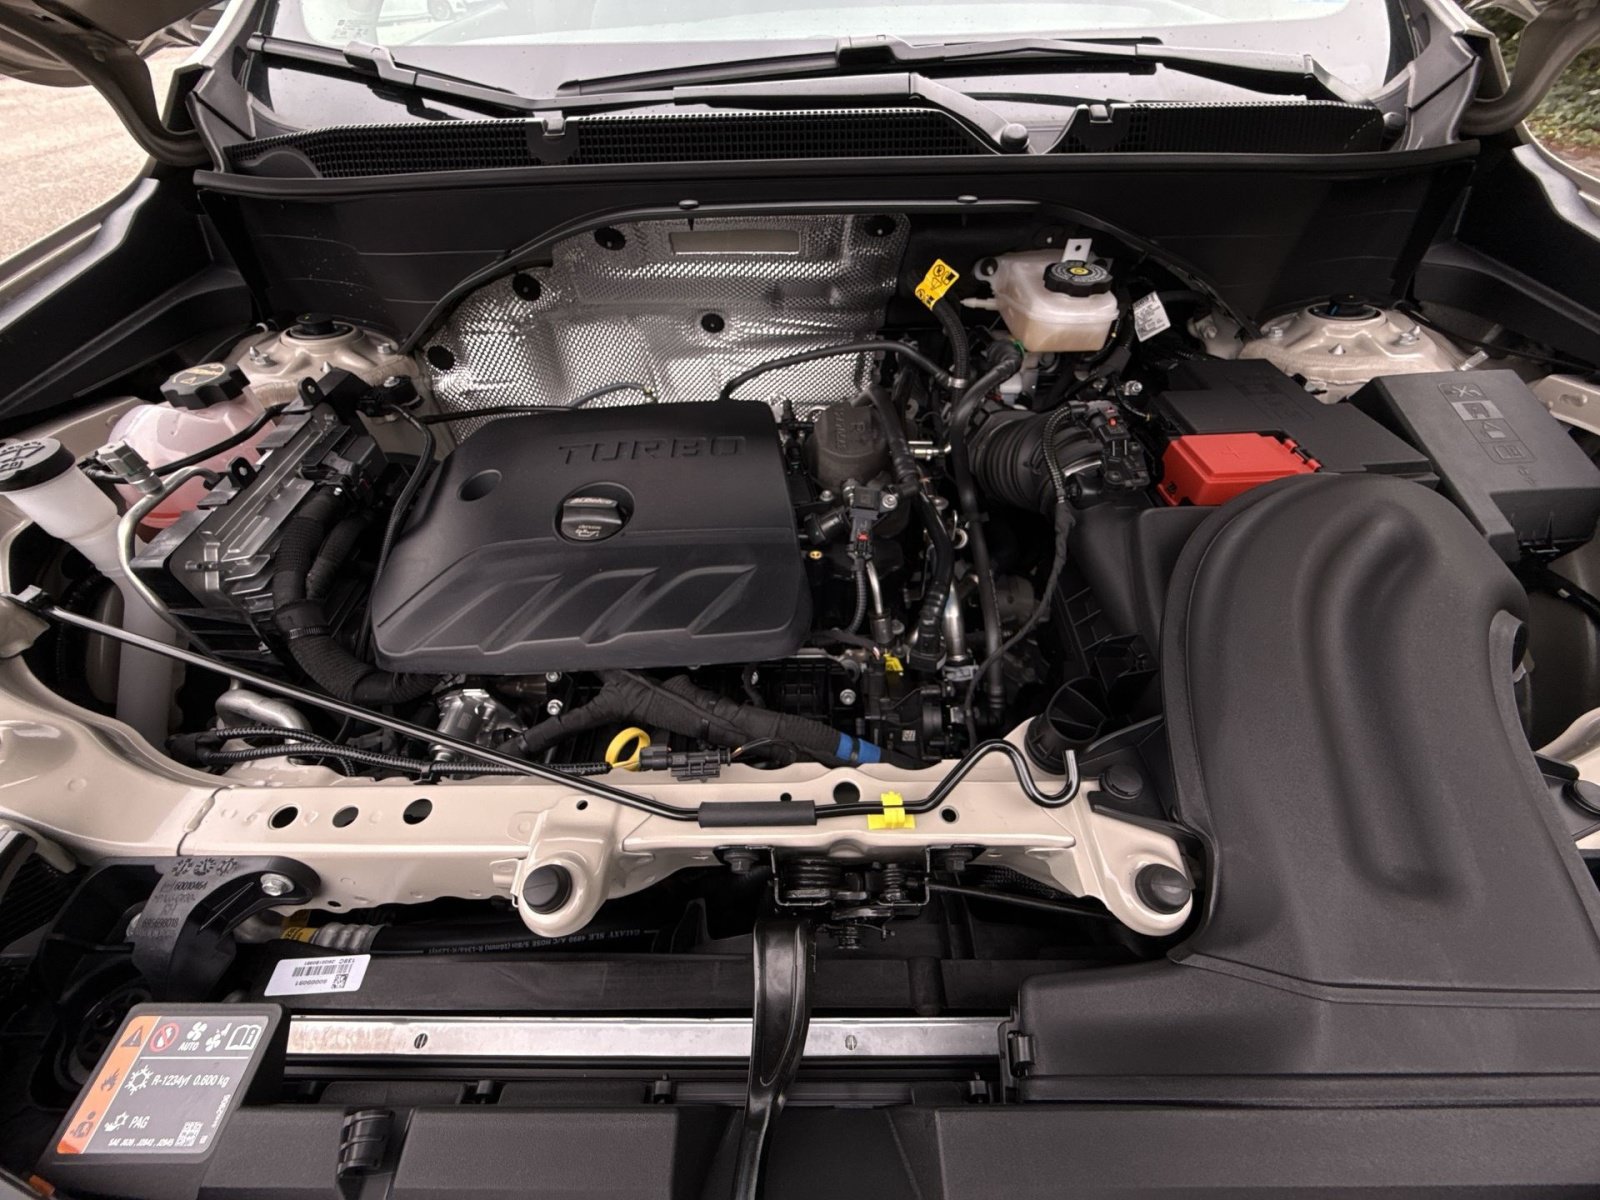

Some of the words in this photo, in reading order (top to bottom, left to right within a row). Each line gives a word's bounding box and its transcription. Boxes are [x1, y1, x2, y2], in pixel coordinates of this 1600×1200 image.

[558, 436, 747, 465] TURBO
[532, 938, 551, 948] HOSE
[177, 1041, 200, 1051] AUTO
[151, 1074, 192, 1088] R-1234yf
[193, 1074, 216, 1086] 0.600
[217, 1074, 230, 1088] kg
[128, 1115, 150, 1129] PAG
